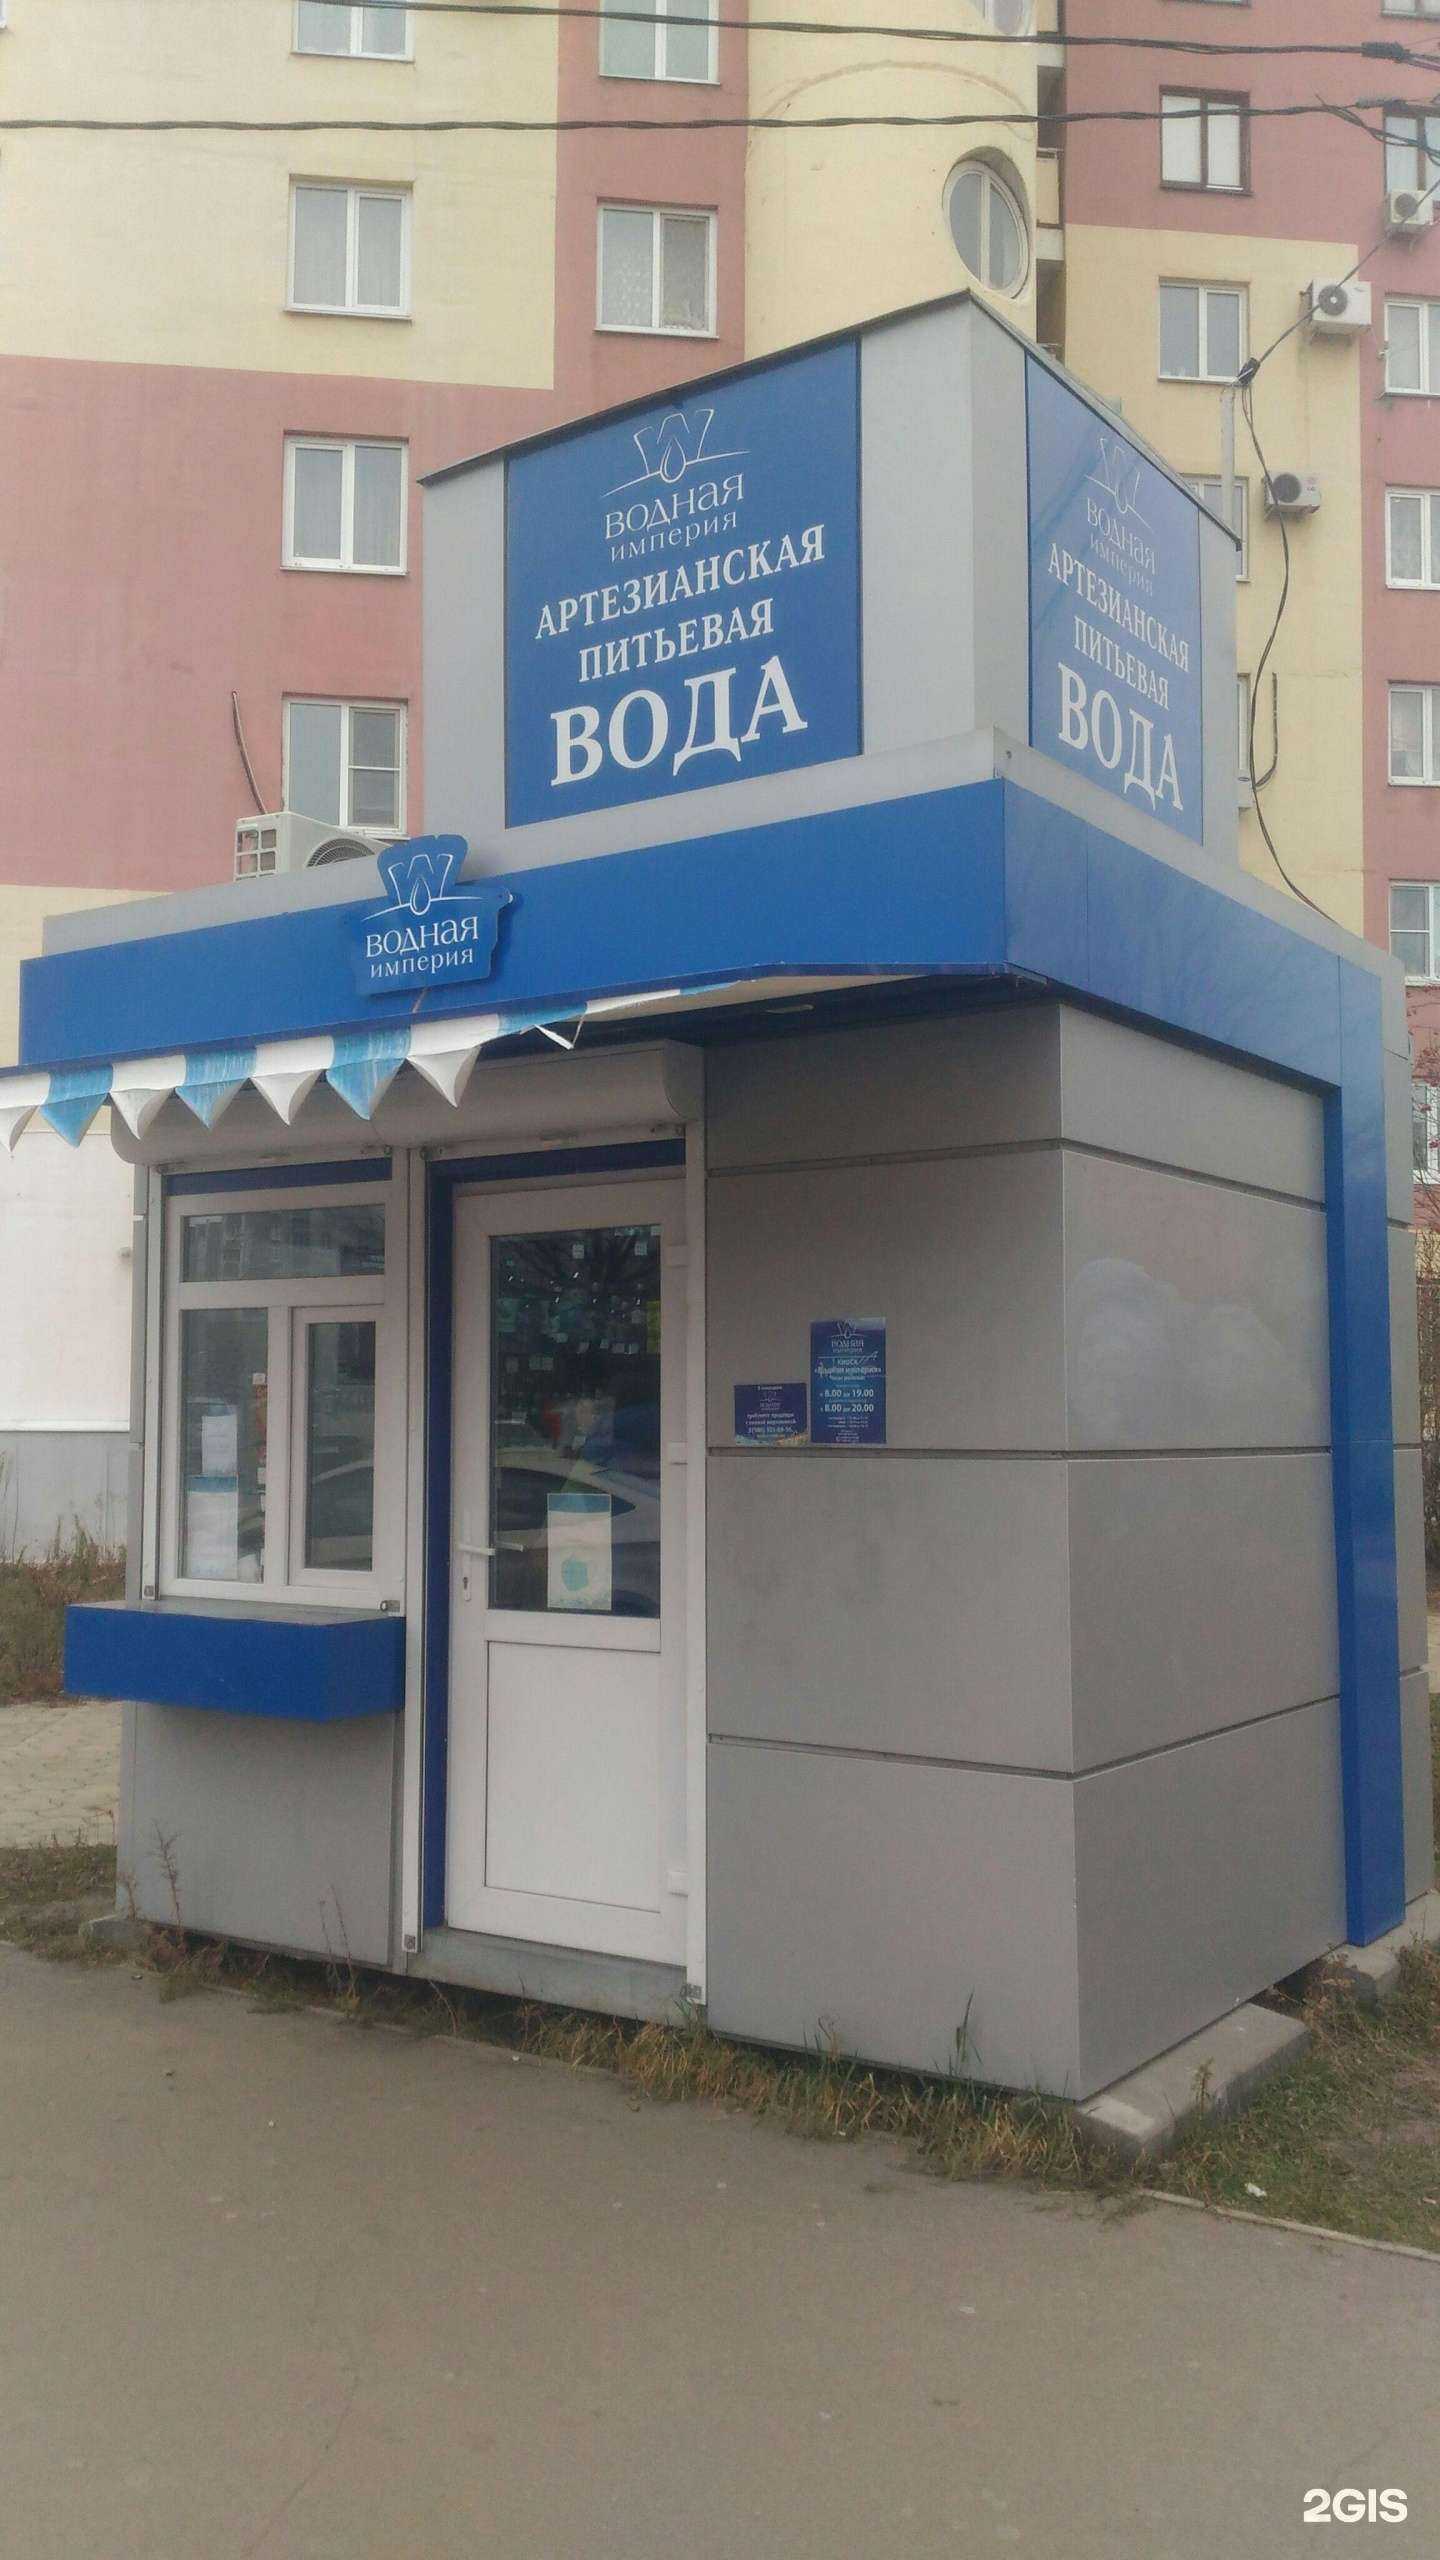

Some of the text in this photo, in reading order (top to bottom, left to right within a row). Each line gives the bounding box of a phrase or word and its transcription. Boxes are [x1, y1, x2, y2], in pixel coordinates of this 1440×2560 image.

[534, 524, 826, 640] АРТЕЗИАНСКАЯ
[610, 510, 738, 564] империя
[578, 597, 775, 683] ПИТЬЕВАЯ
[1047, 542, 1190, 674] АРТЕЗИАНСКАЯ
[1073, 615, 1171, 711] ПИТЬЕВАЯ
[550, 654, 808, 788] ВОДА
[1057, 662, 1184, 811] ВОДА
[370, 947, 474, 979] империя
[851, 1389, 874, 1397] 19.00
[851, 1404, 874, 1412] 20.00
